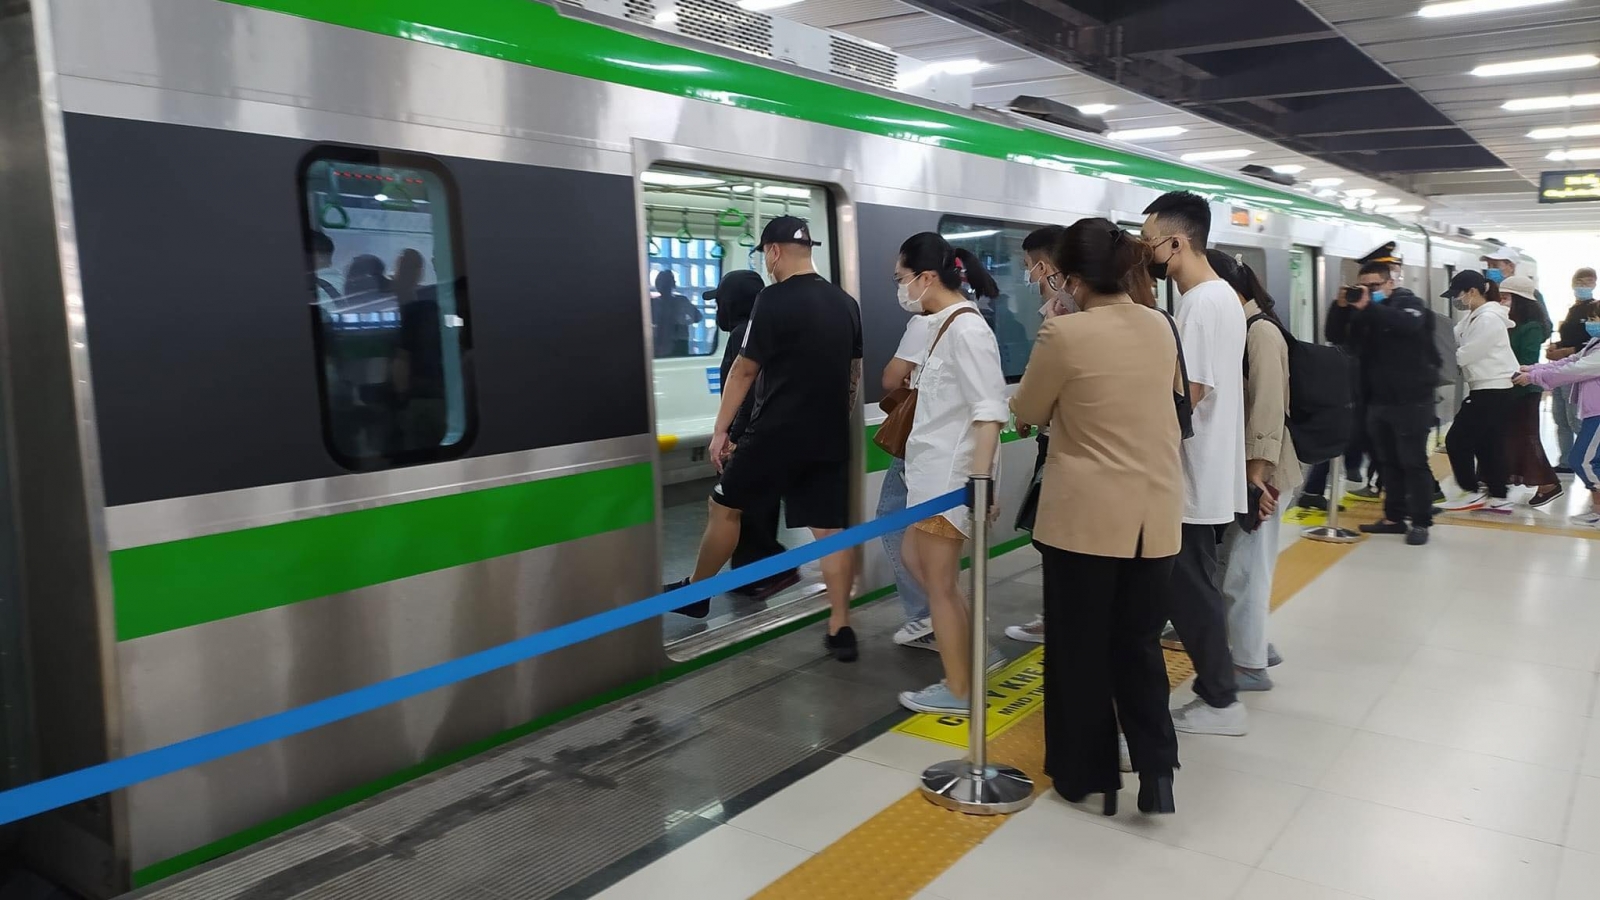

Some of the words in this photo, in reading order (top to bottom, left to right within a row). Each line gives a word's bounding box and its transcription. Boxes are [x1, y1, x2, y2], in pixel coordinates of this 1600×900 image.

[998, 667, 1045, 690] KHE
[998, 696, 1033, 716] MIND
[1026, 684, 1045, 697] TH
